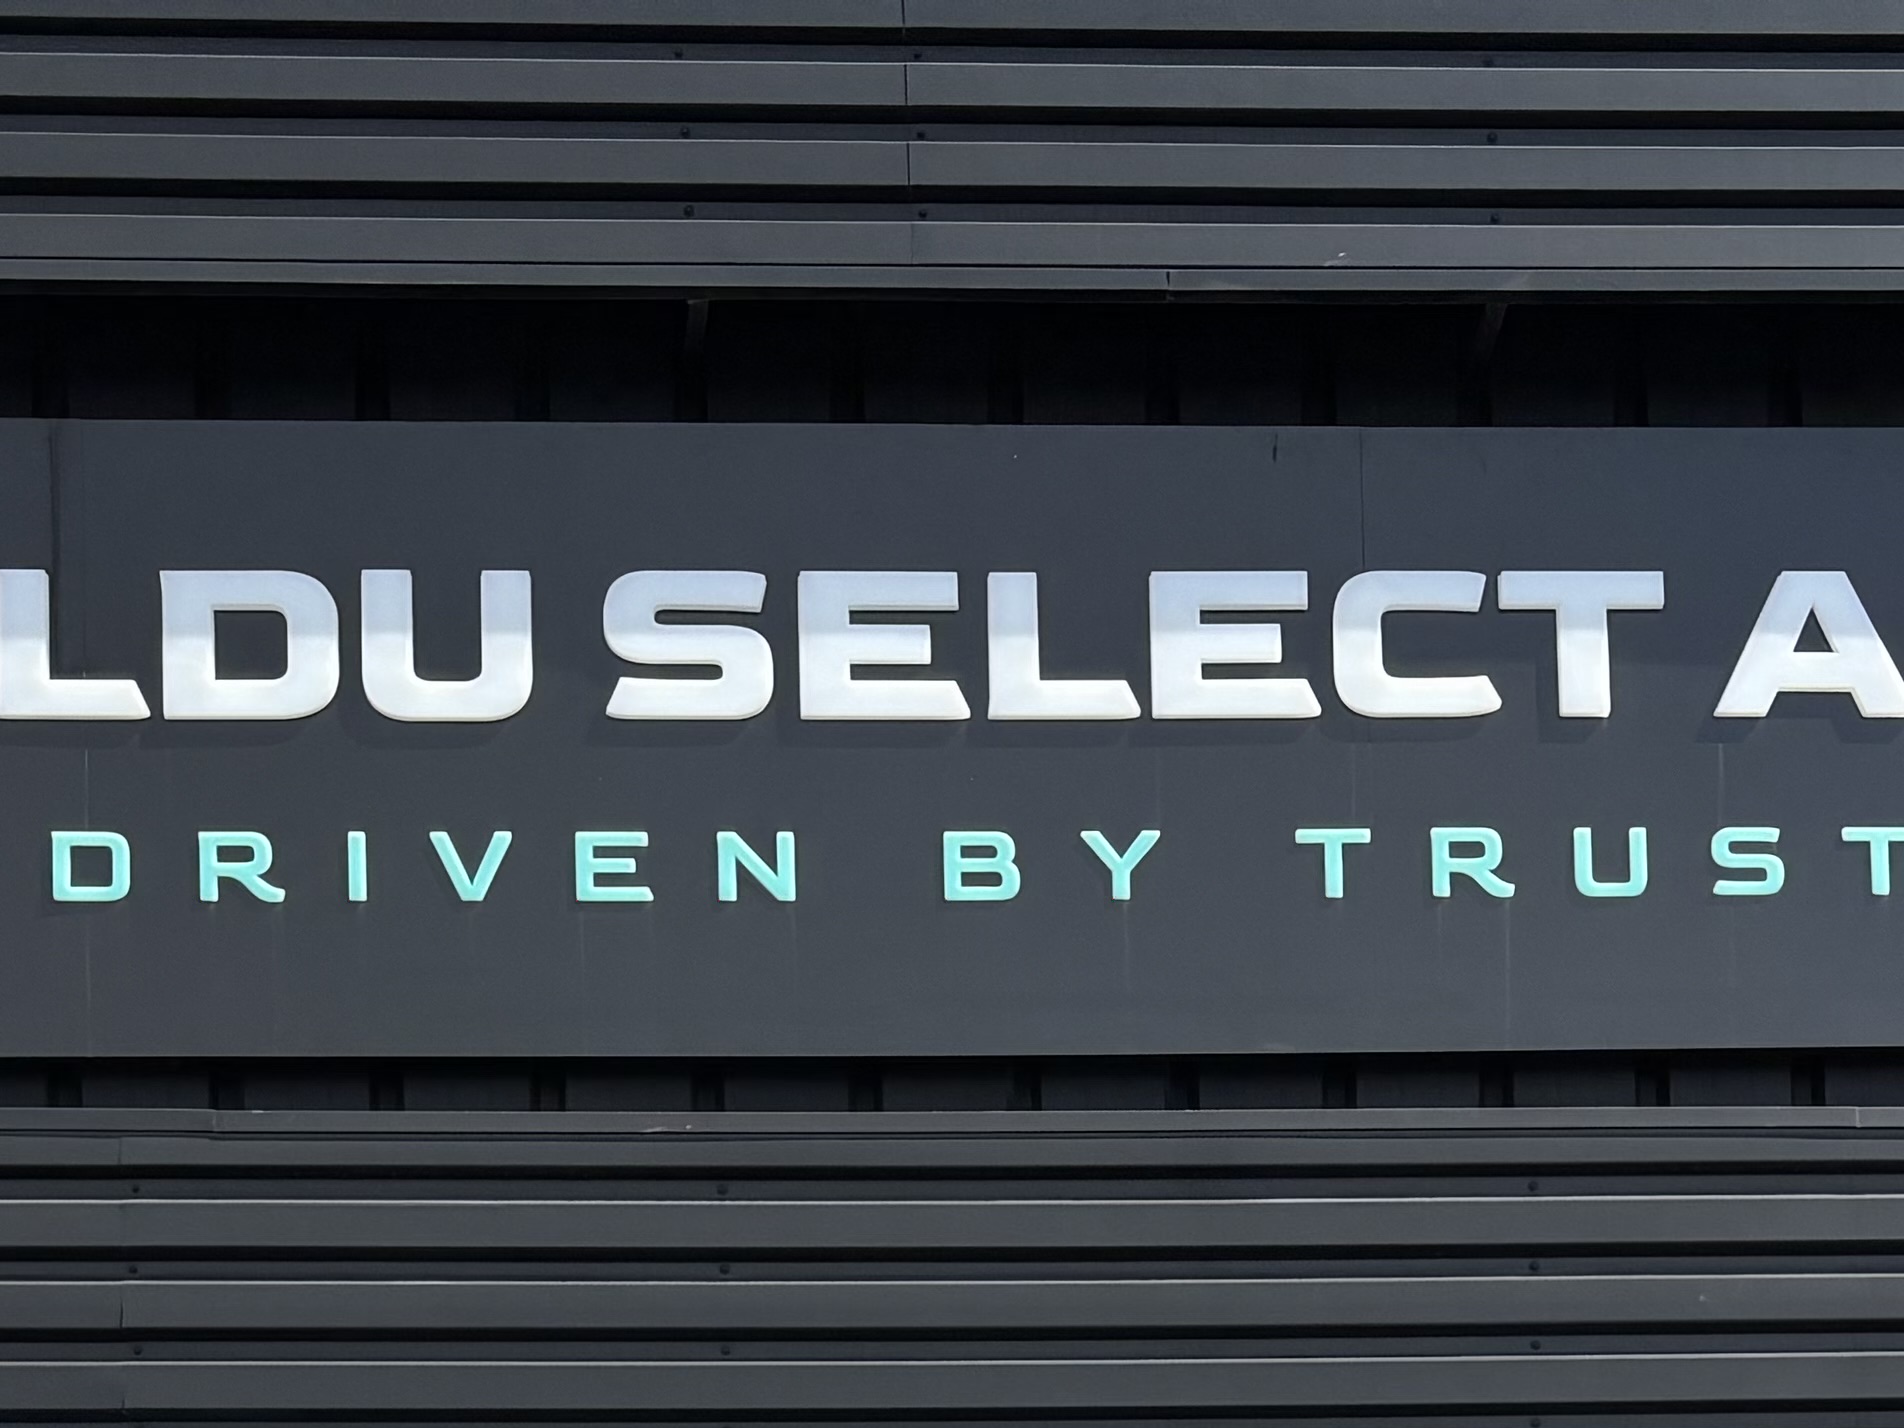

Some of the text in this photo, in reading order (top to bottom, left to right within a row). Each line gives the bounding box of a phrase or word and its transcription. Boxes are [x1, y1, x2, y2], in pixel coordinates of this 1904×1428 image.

[601, 569, 1665, 721] SELECT
[49, 829, 797, 902] DRIVEN
[941, 829, 1161, 901] BY
